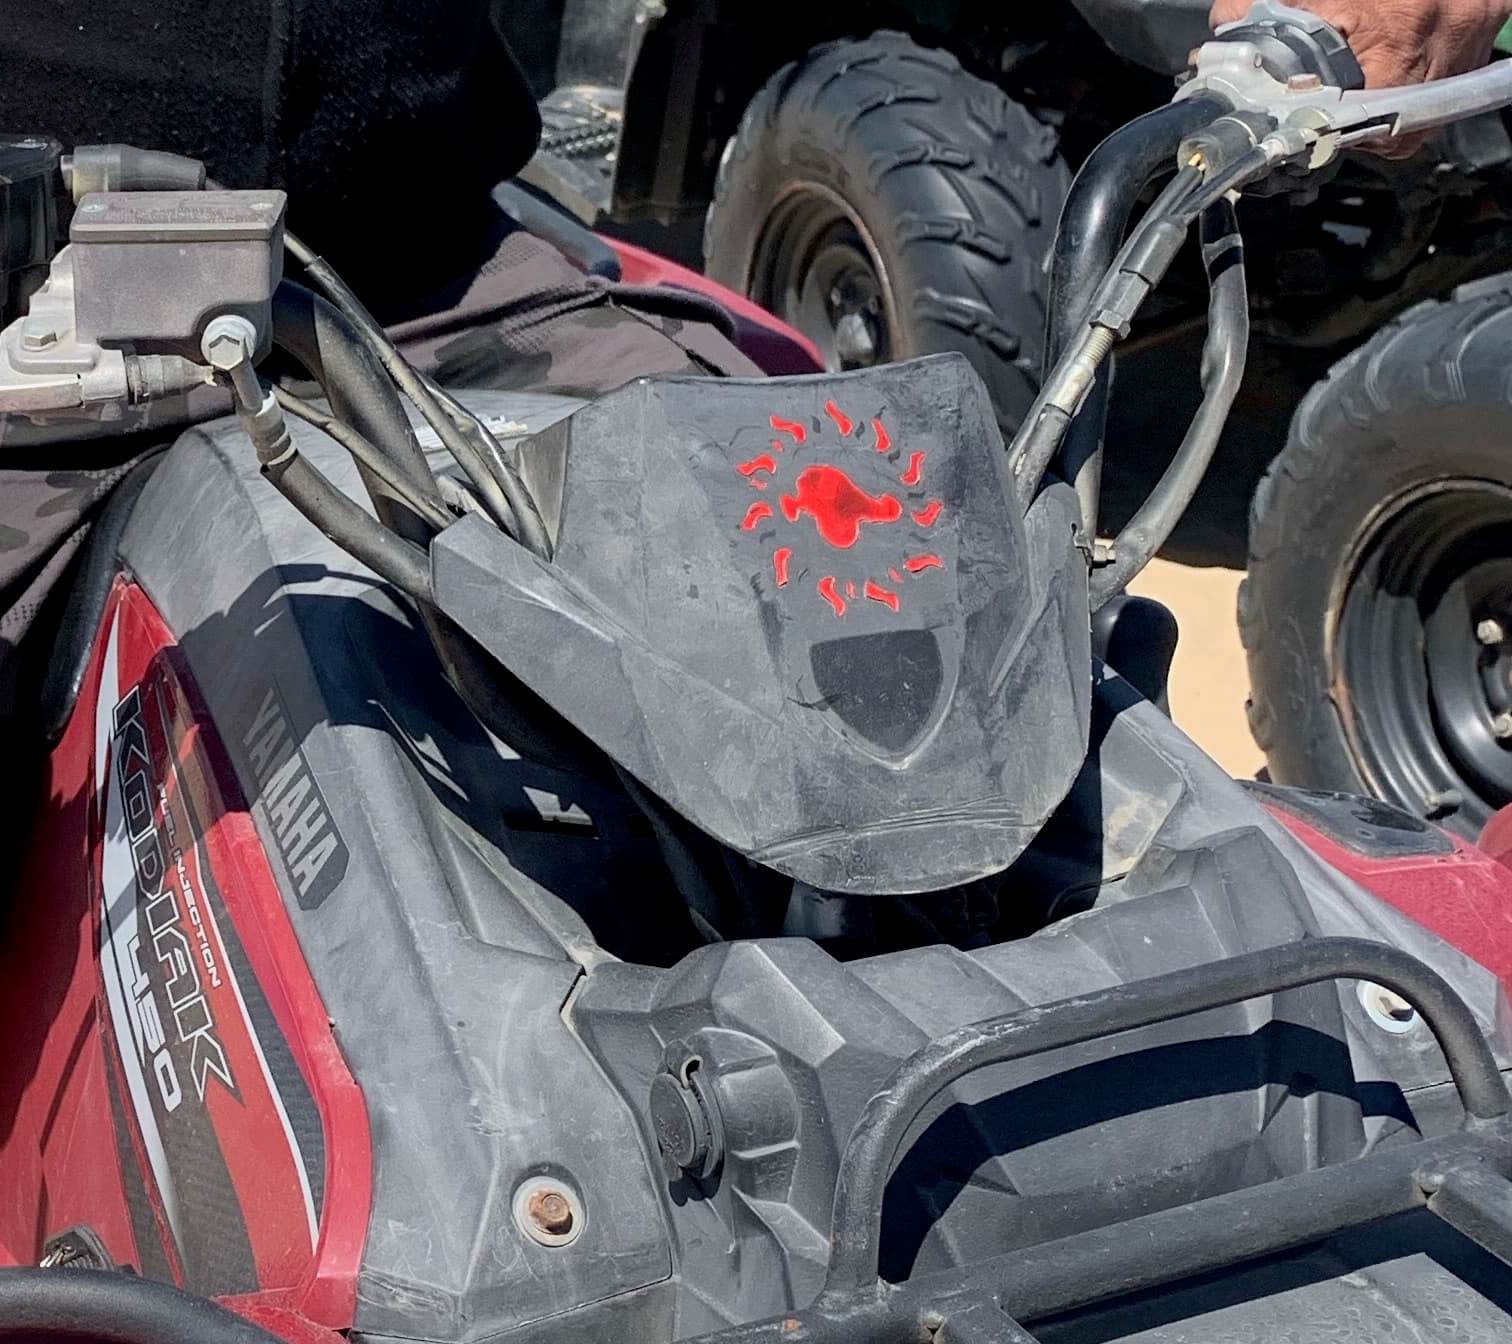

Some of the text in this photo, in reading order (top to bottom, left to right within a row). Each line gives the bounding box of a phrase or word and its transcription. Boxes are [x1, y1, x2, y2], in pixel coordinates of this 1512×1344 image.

[112, 685, 235, 1103] KODIAK
[157, 782, 222, 989] FUEL INJECTION
[243, 688, 338, 897] YAMAHA
[127, 935, 182, 1112] 450
